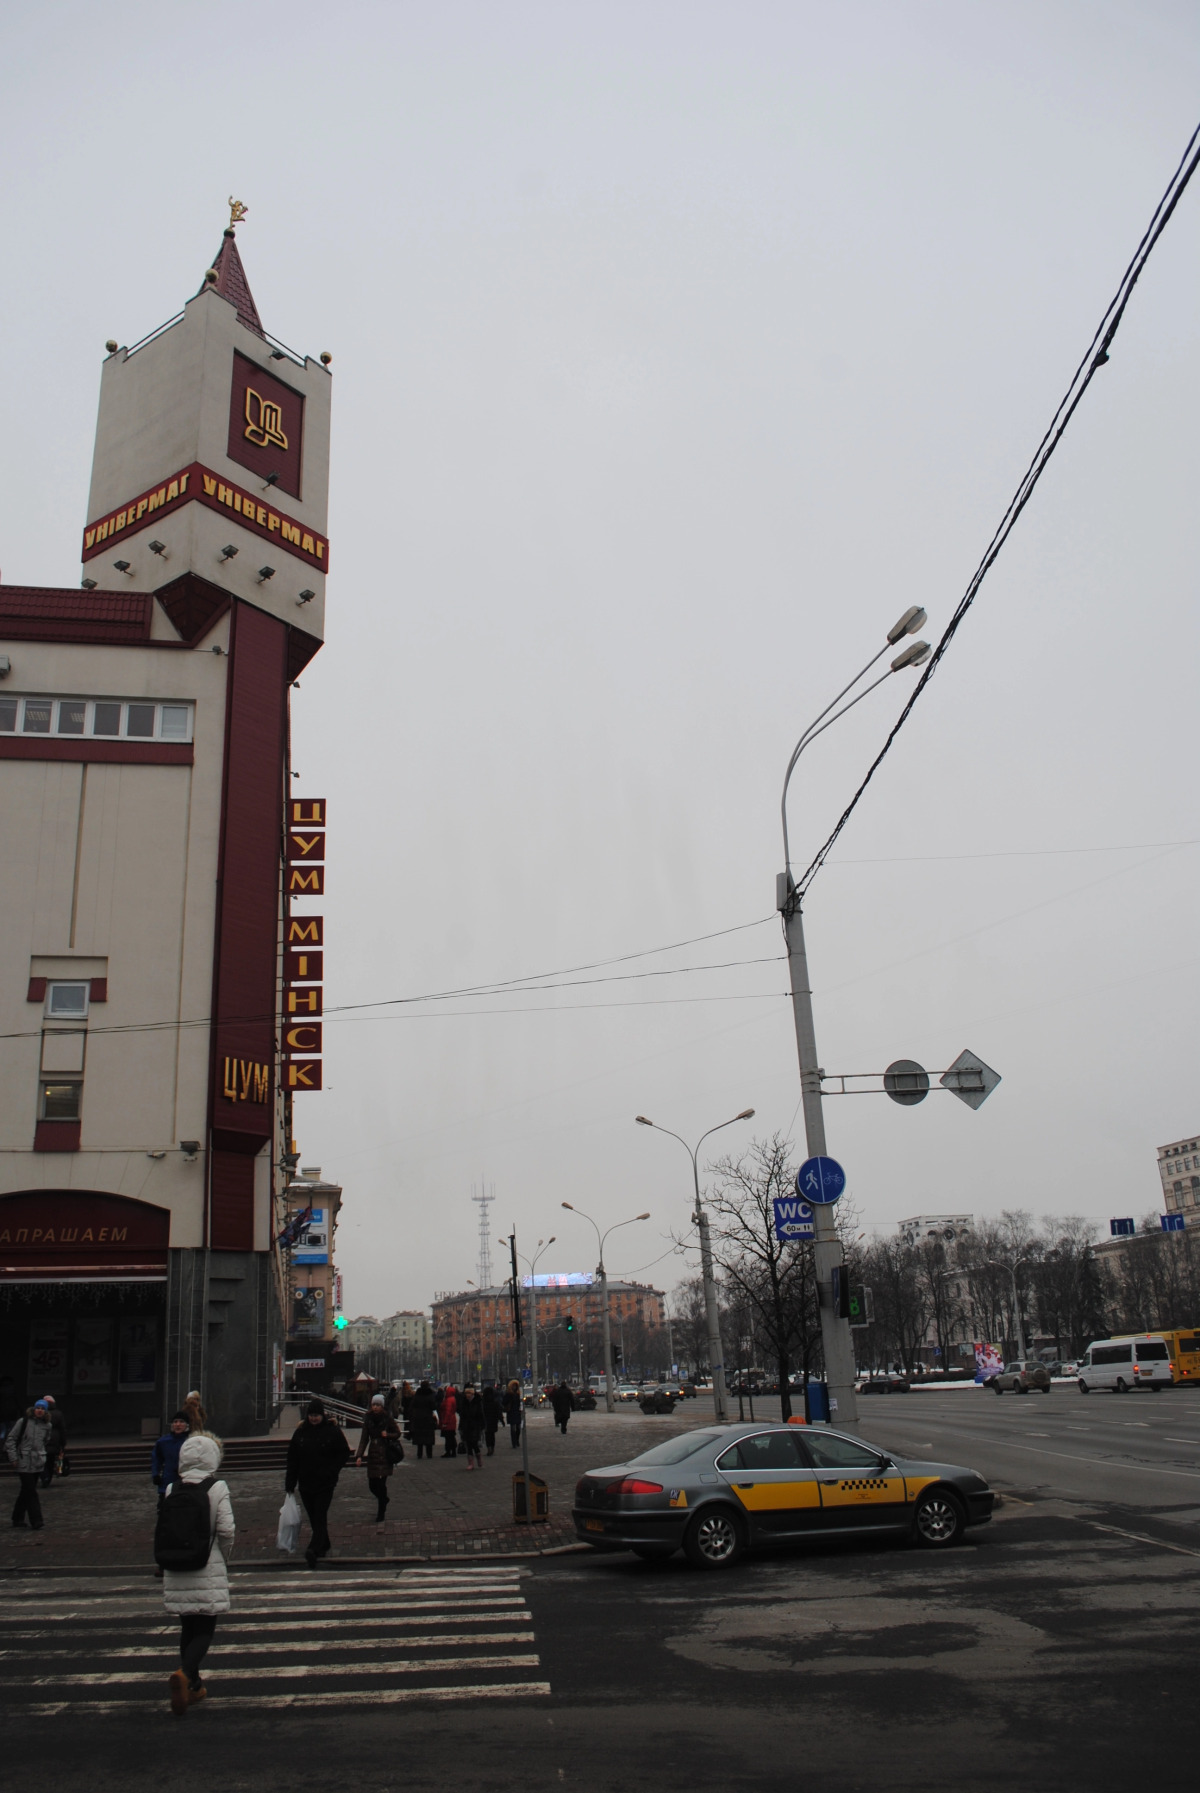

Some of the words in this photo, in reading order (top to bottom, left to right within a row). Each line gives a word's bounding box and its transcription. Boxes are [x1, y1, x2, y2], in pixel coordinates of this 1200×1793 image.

[85, 474, 190, 550] УНІВЕРМАГ
[202, 474, 326, 558] УНІВЕРМАГ
[290, 802, 322, 890] ЦУМ
[287, 921, 319, 1086] МІНСК
[223, 1056, 269, 1104] ЦУМ
[778, 1203, 811, 1218] WC
